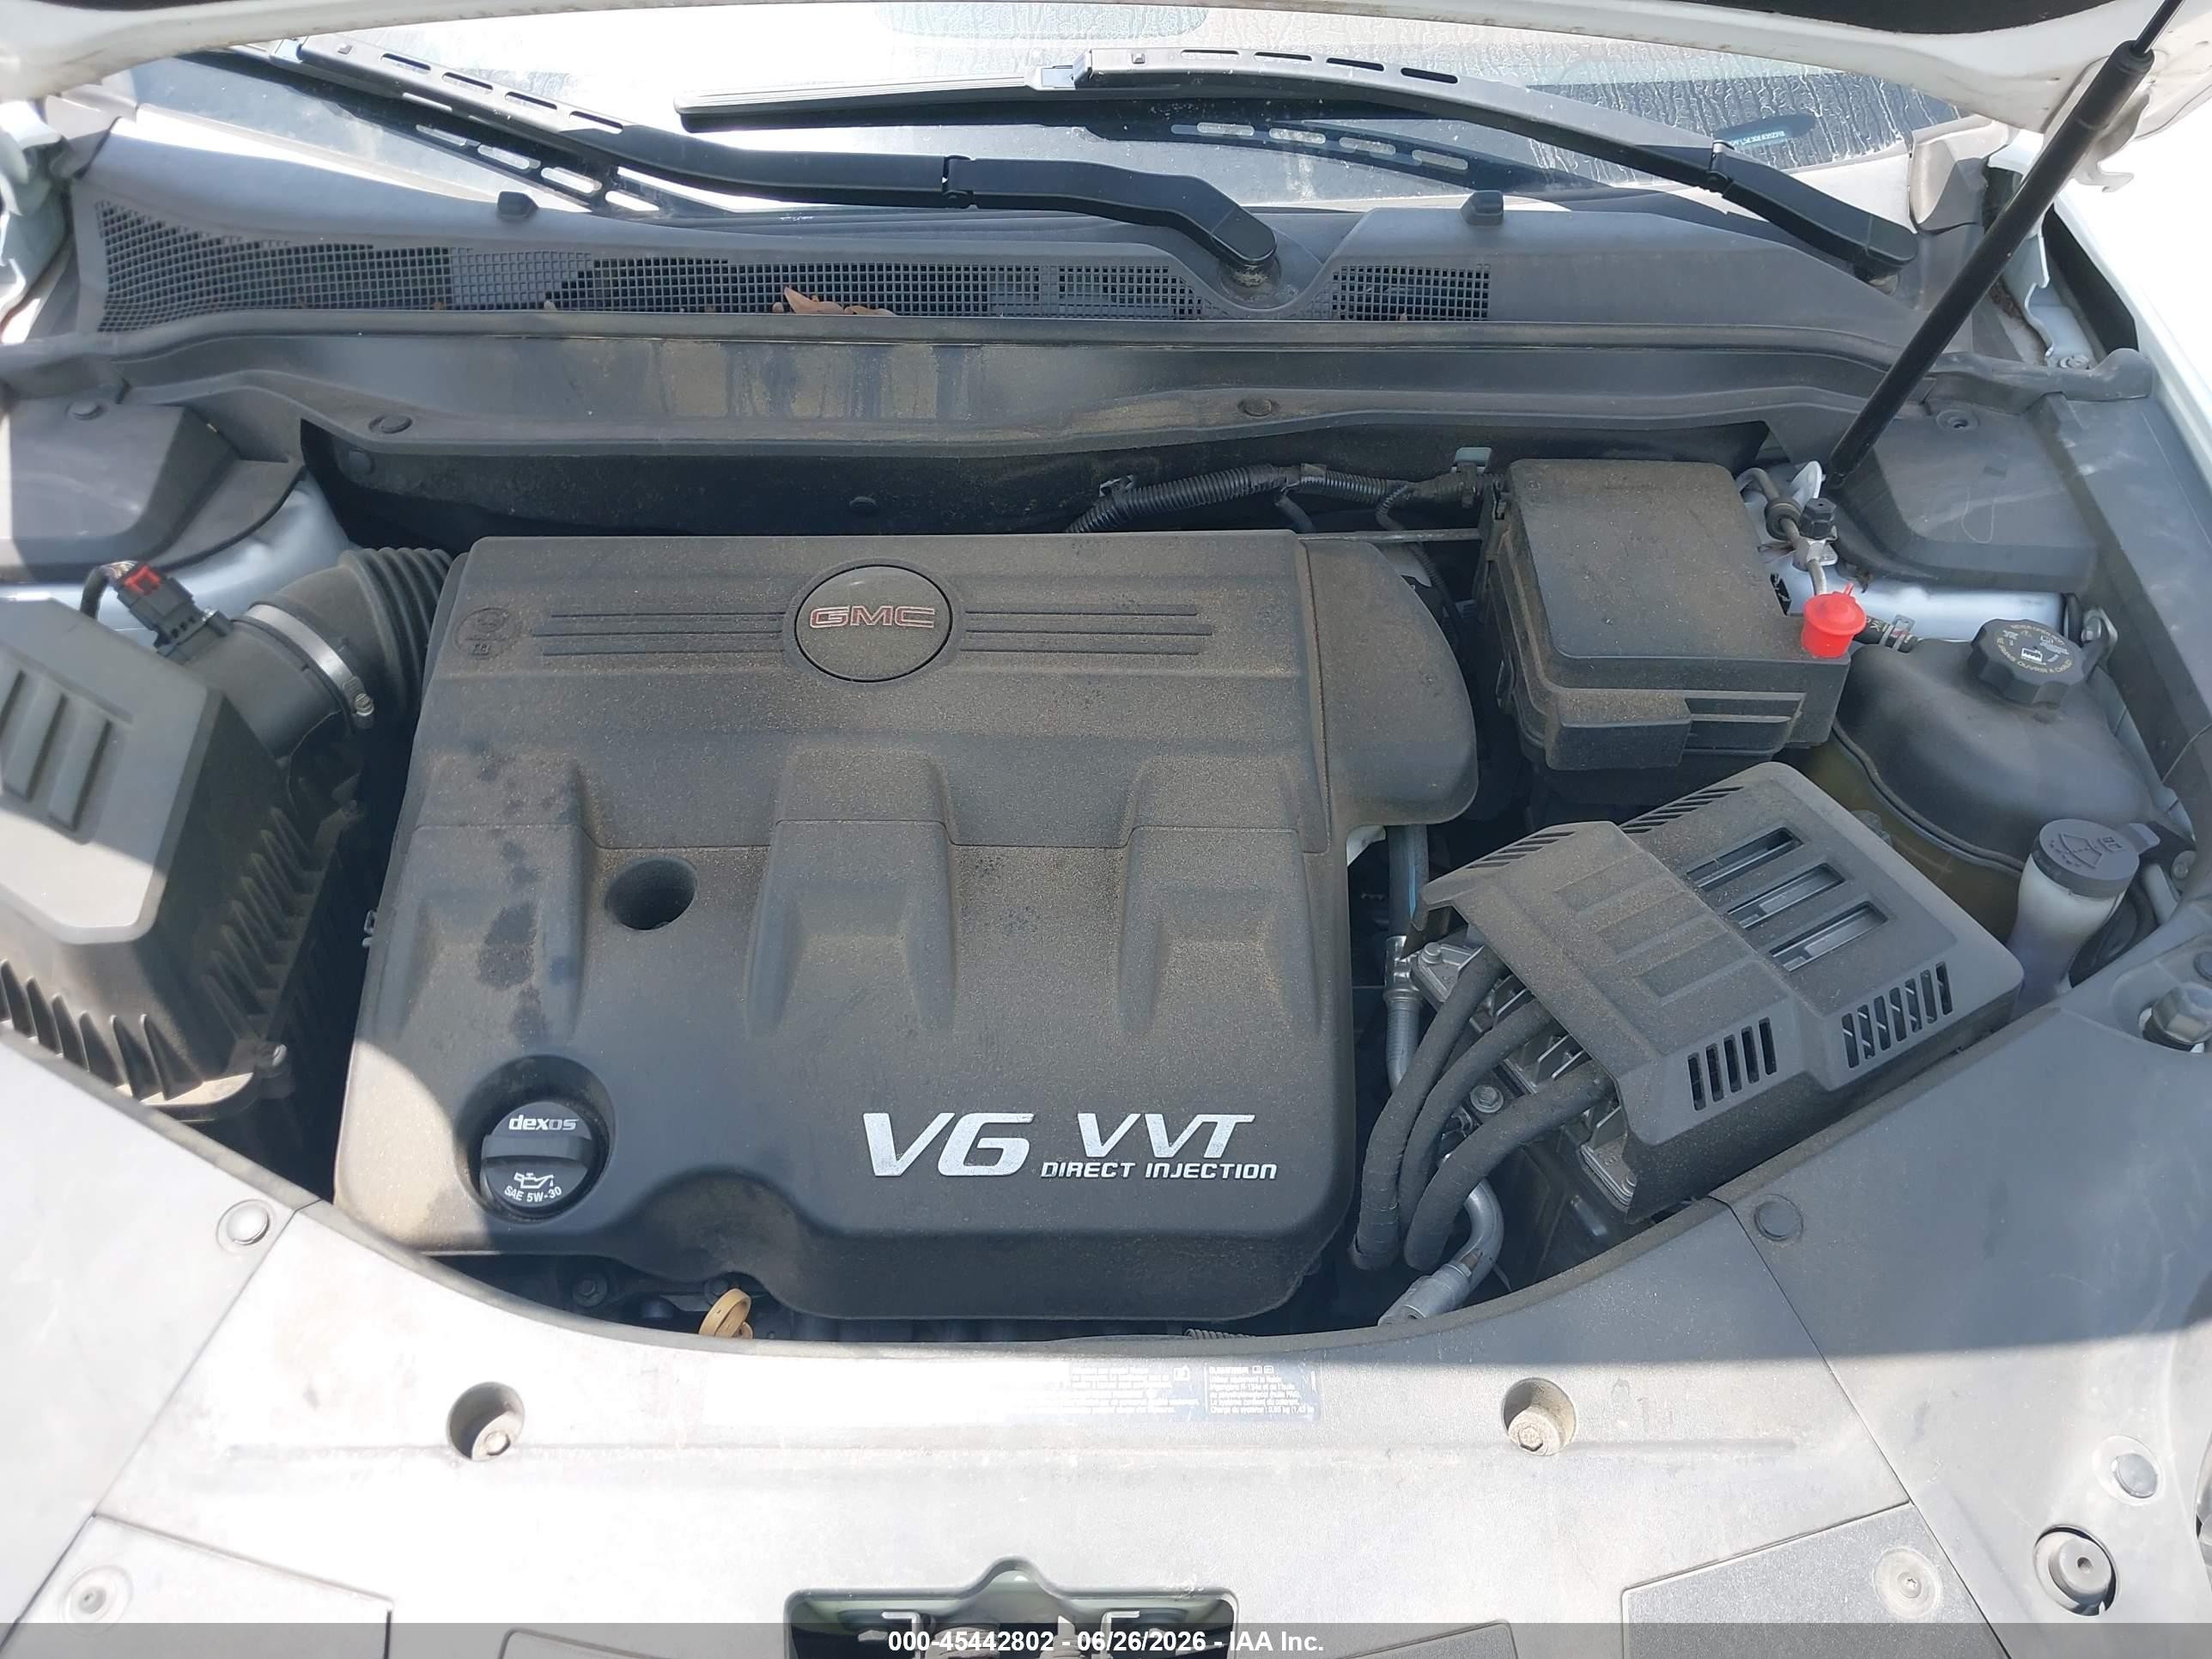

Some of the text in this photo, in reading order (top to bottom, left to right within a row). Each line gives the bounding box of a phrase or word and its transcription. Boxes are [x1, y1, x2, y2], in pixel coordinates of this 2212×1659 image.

[810, 605, 935, 629] GMC
[508, 1115, 580, 1131] dexos
[863, 1113, 1255, 1176] V6 VVT
[1041, 1162, 1278, 1179] DIRECT INJECTION
[504, 1186, 562, 1202] SAE 5W-30
